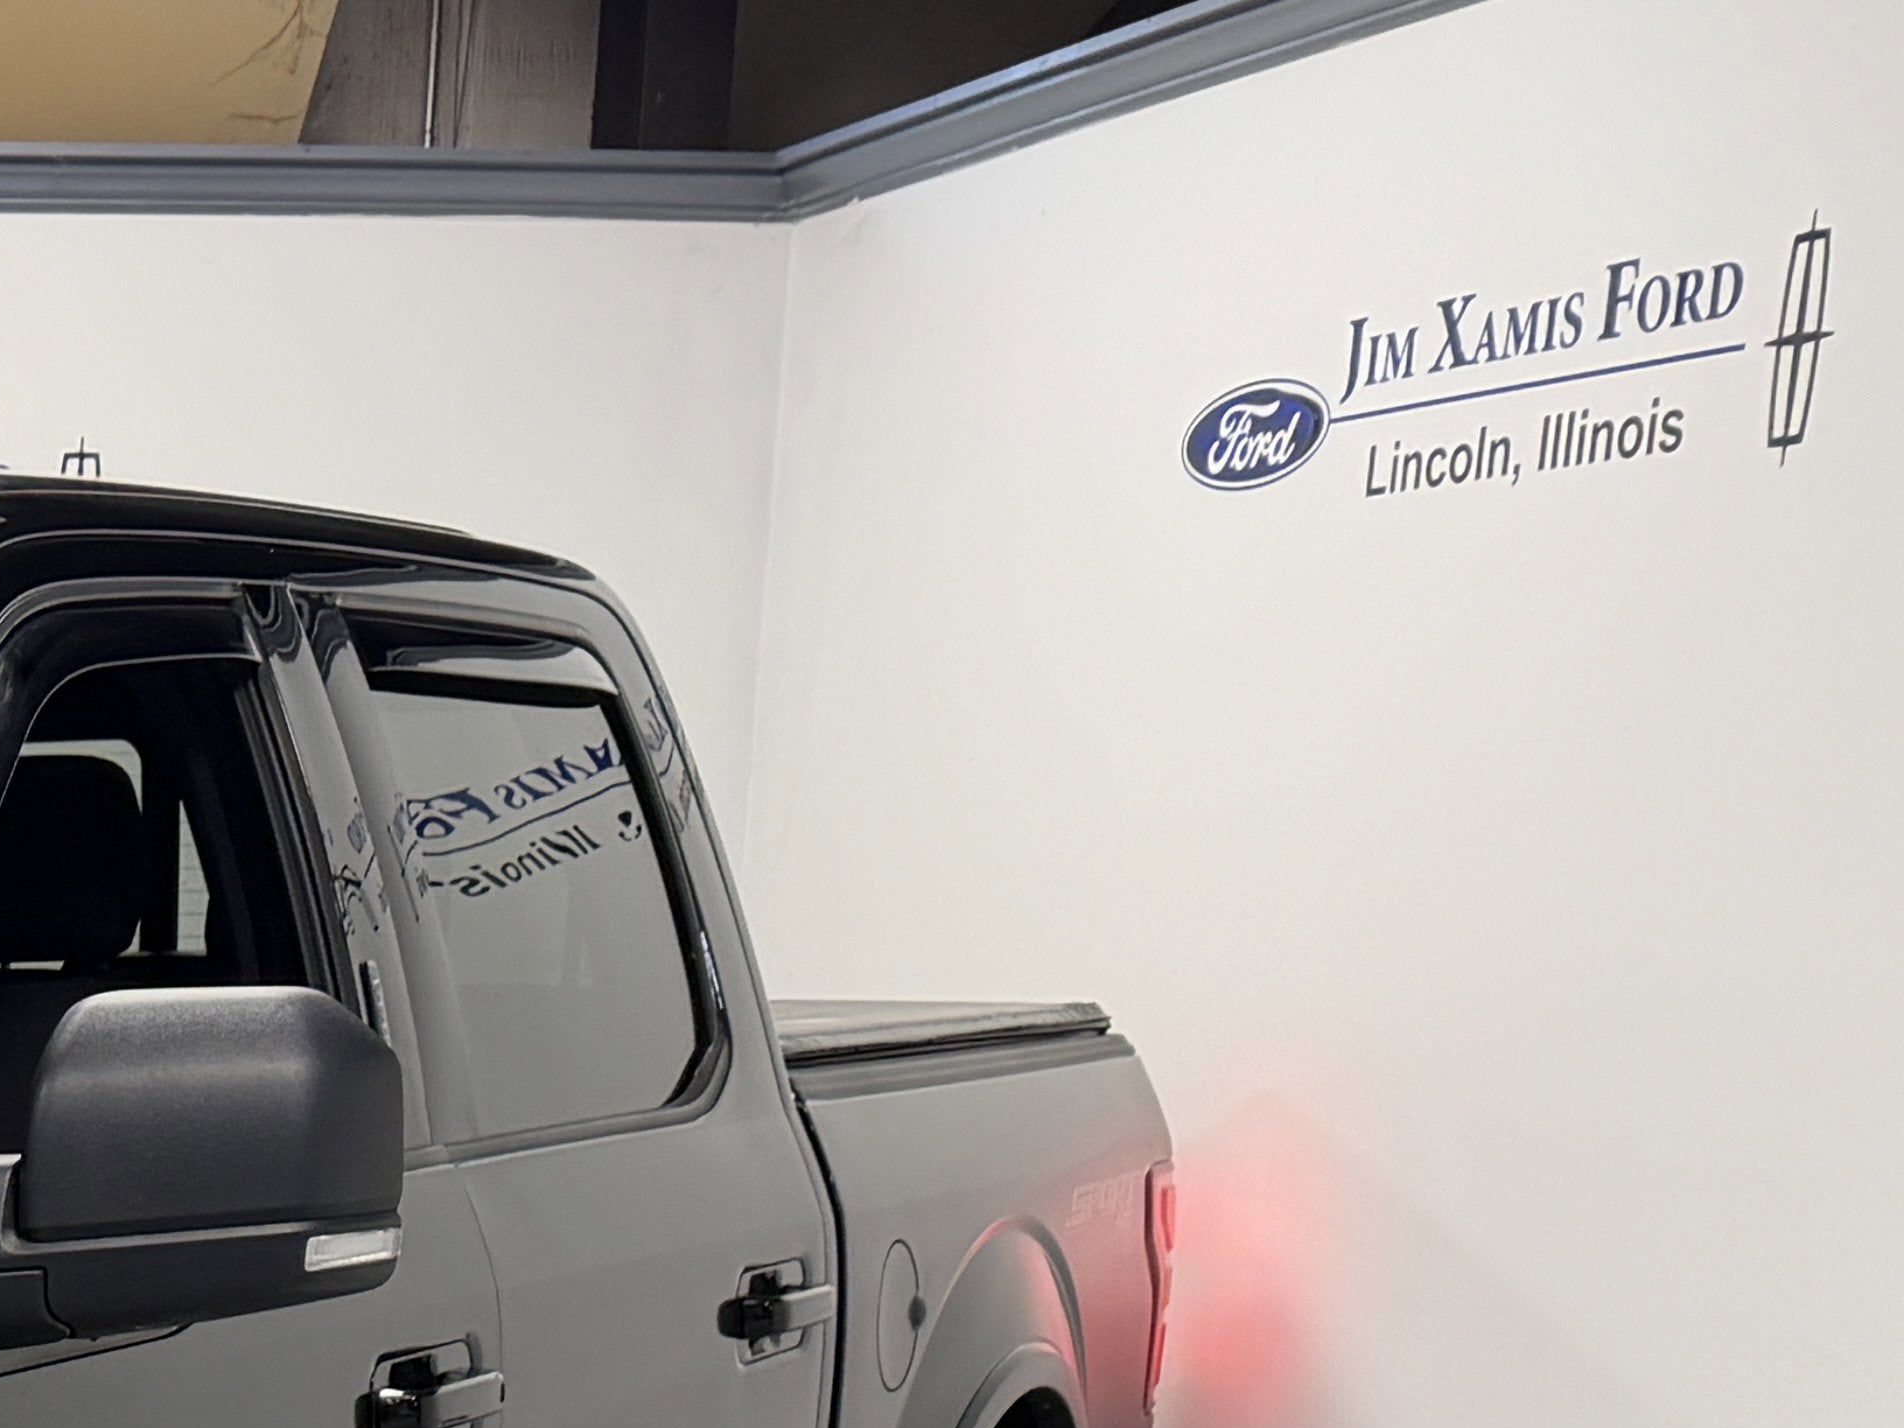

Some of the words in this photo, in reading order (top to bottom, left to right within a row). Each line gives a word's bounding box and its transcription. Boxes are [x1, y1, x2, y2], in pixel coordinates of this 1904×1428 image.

[1340, 317, 1419, 404] JIM
[1428, 292, 1584, 373] XAMIS
[1599, 257, 1744, 341] FORD
[1207, 399, 1302, 475] Ford
[1365, 427, 1521, 498] Lincoln,
[1537, 396, 1684, 471] Illinois
